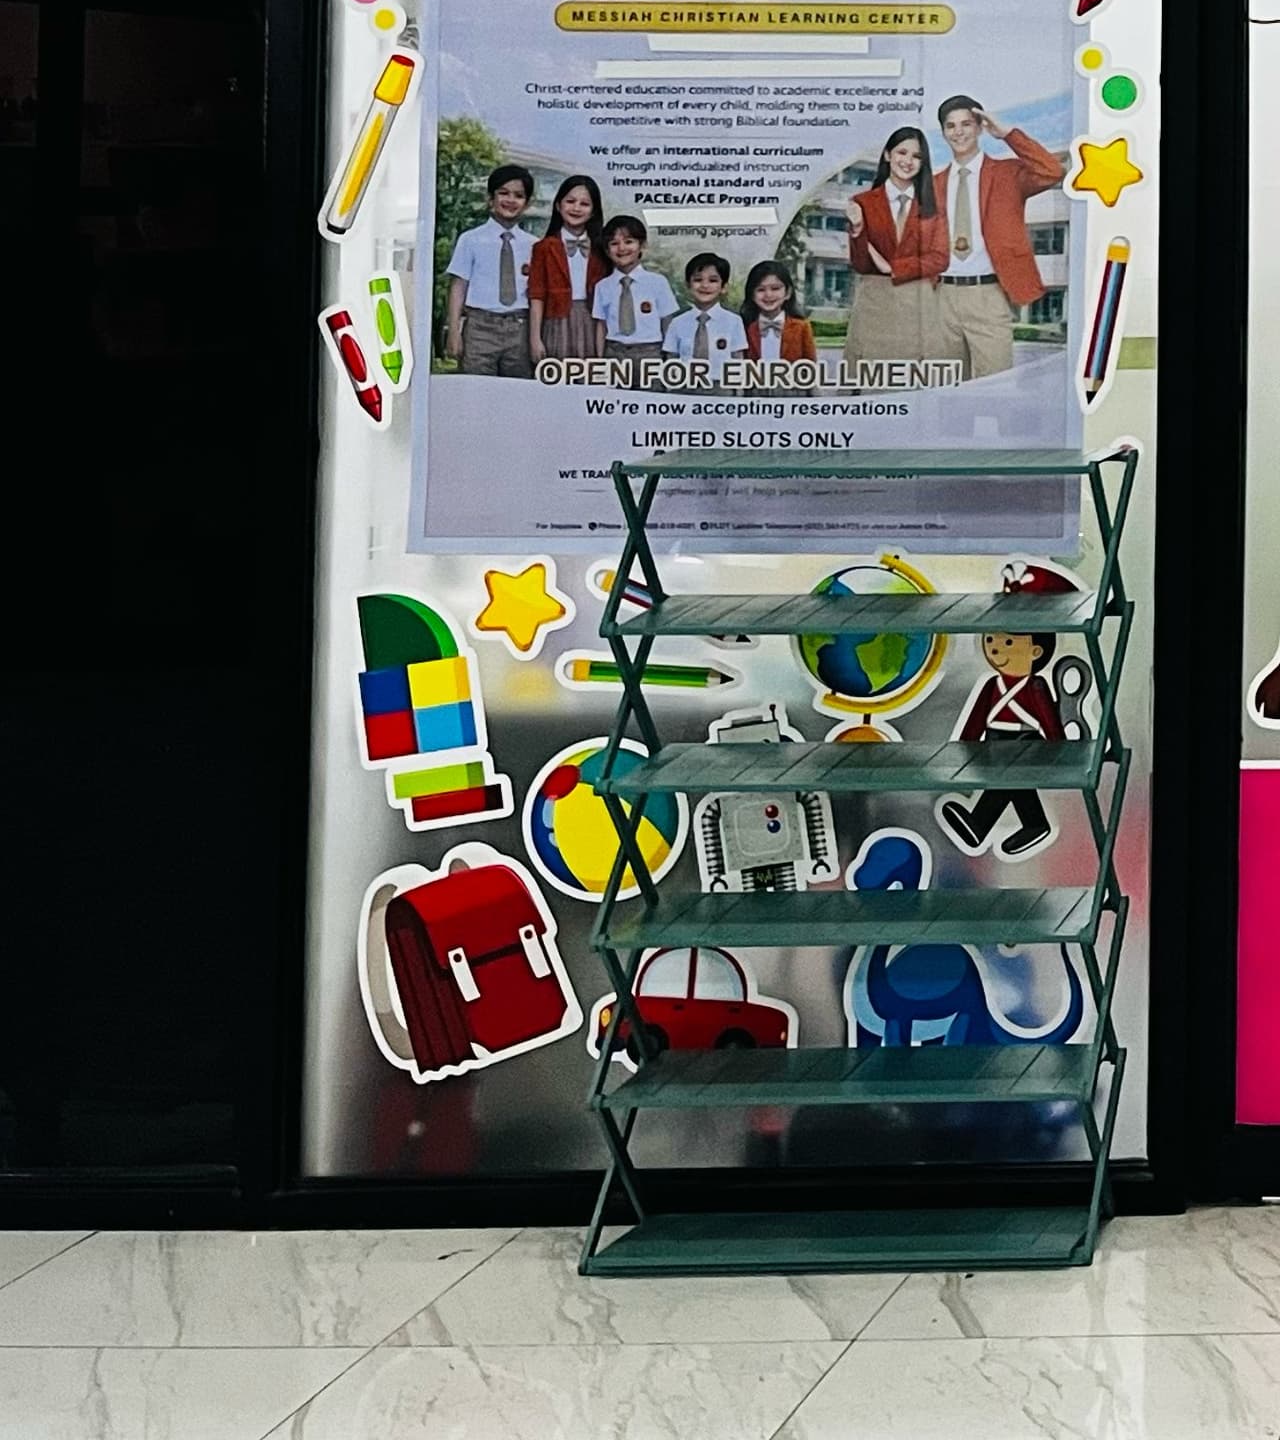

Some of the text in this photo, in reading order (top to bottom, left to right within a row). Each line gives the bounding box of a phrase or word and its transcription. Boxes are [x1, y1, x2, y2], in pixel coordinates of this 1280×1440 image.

[572, 10, 940, 25] MESSIAH CHRISTIAN LEARNING CENTER
[525, 82, 924, 97] Christ-centered education committed academic excellence and
[538, 98, 923, 115] holistic development every molding them globally
[590, 115, 779, 130] competitive with strong Biblical
[590, 144, 824, 157] We offer international curriculum
[607, 160, 809, 173] through individualized instruction
[612, 176, 802, 190] international standard using
[634, 192, 780, 207] PACEs/ACE Program
[657, 226, 707, 239] learning
[537, 359, 964, 389] OPEN FOR ENROLLMENT!
[586, 400, 909, 419] We're now accepting reservations
[632, 431, 855, 448] LIMITED SLOTS ONLY
[559, 470, 614, 479] WE TRAI
